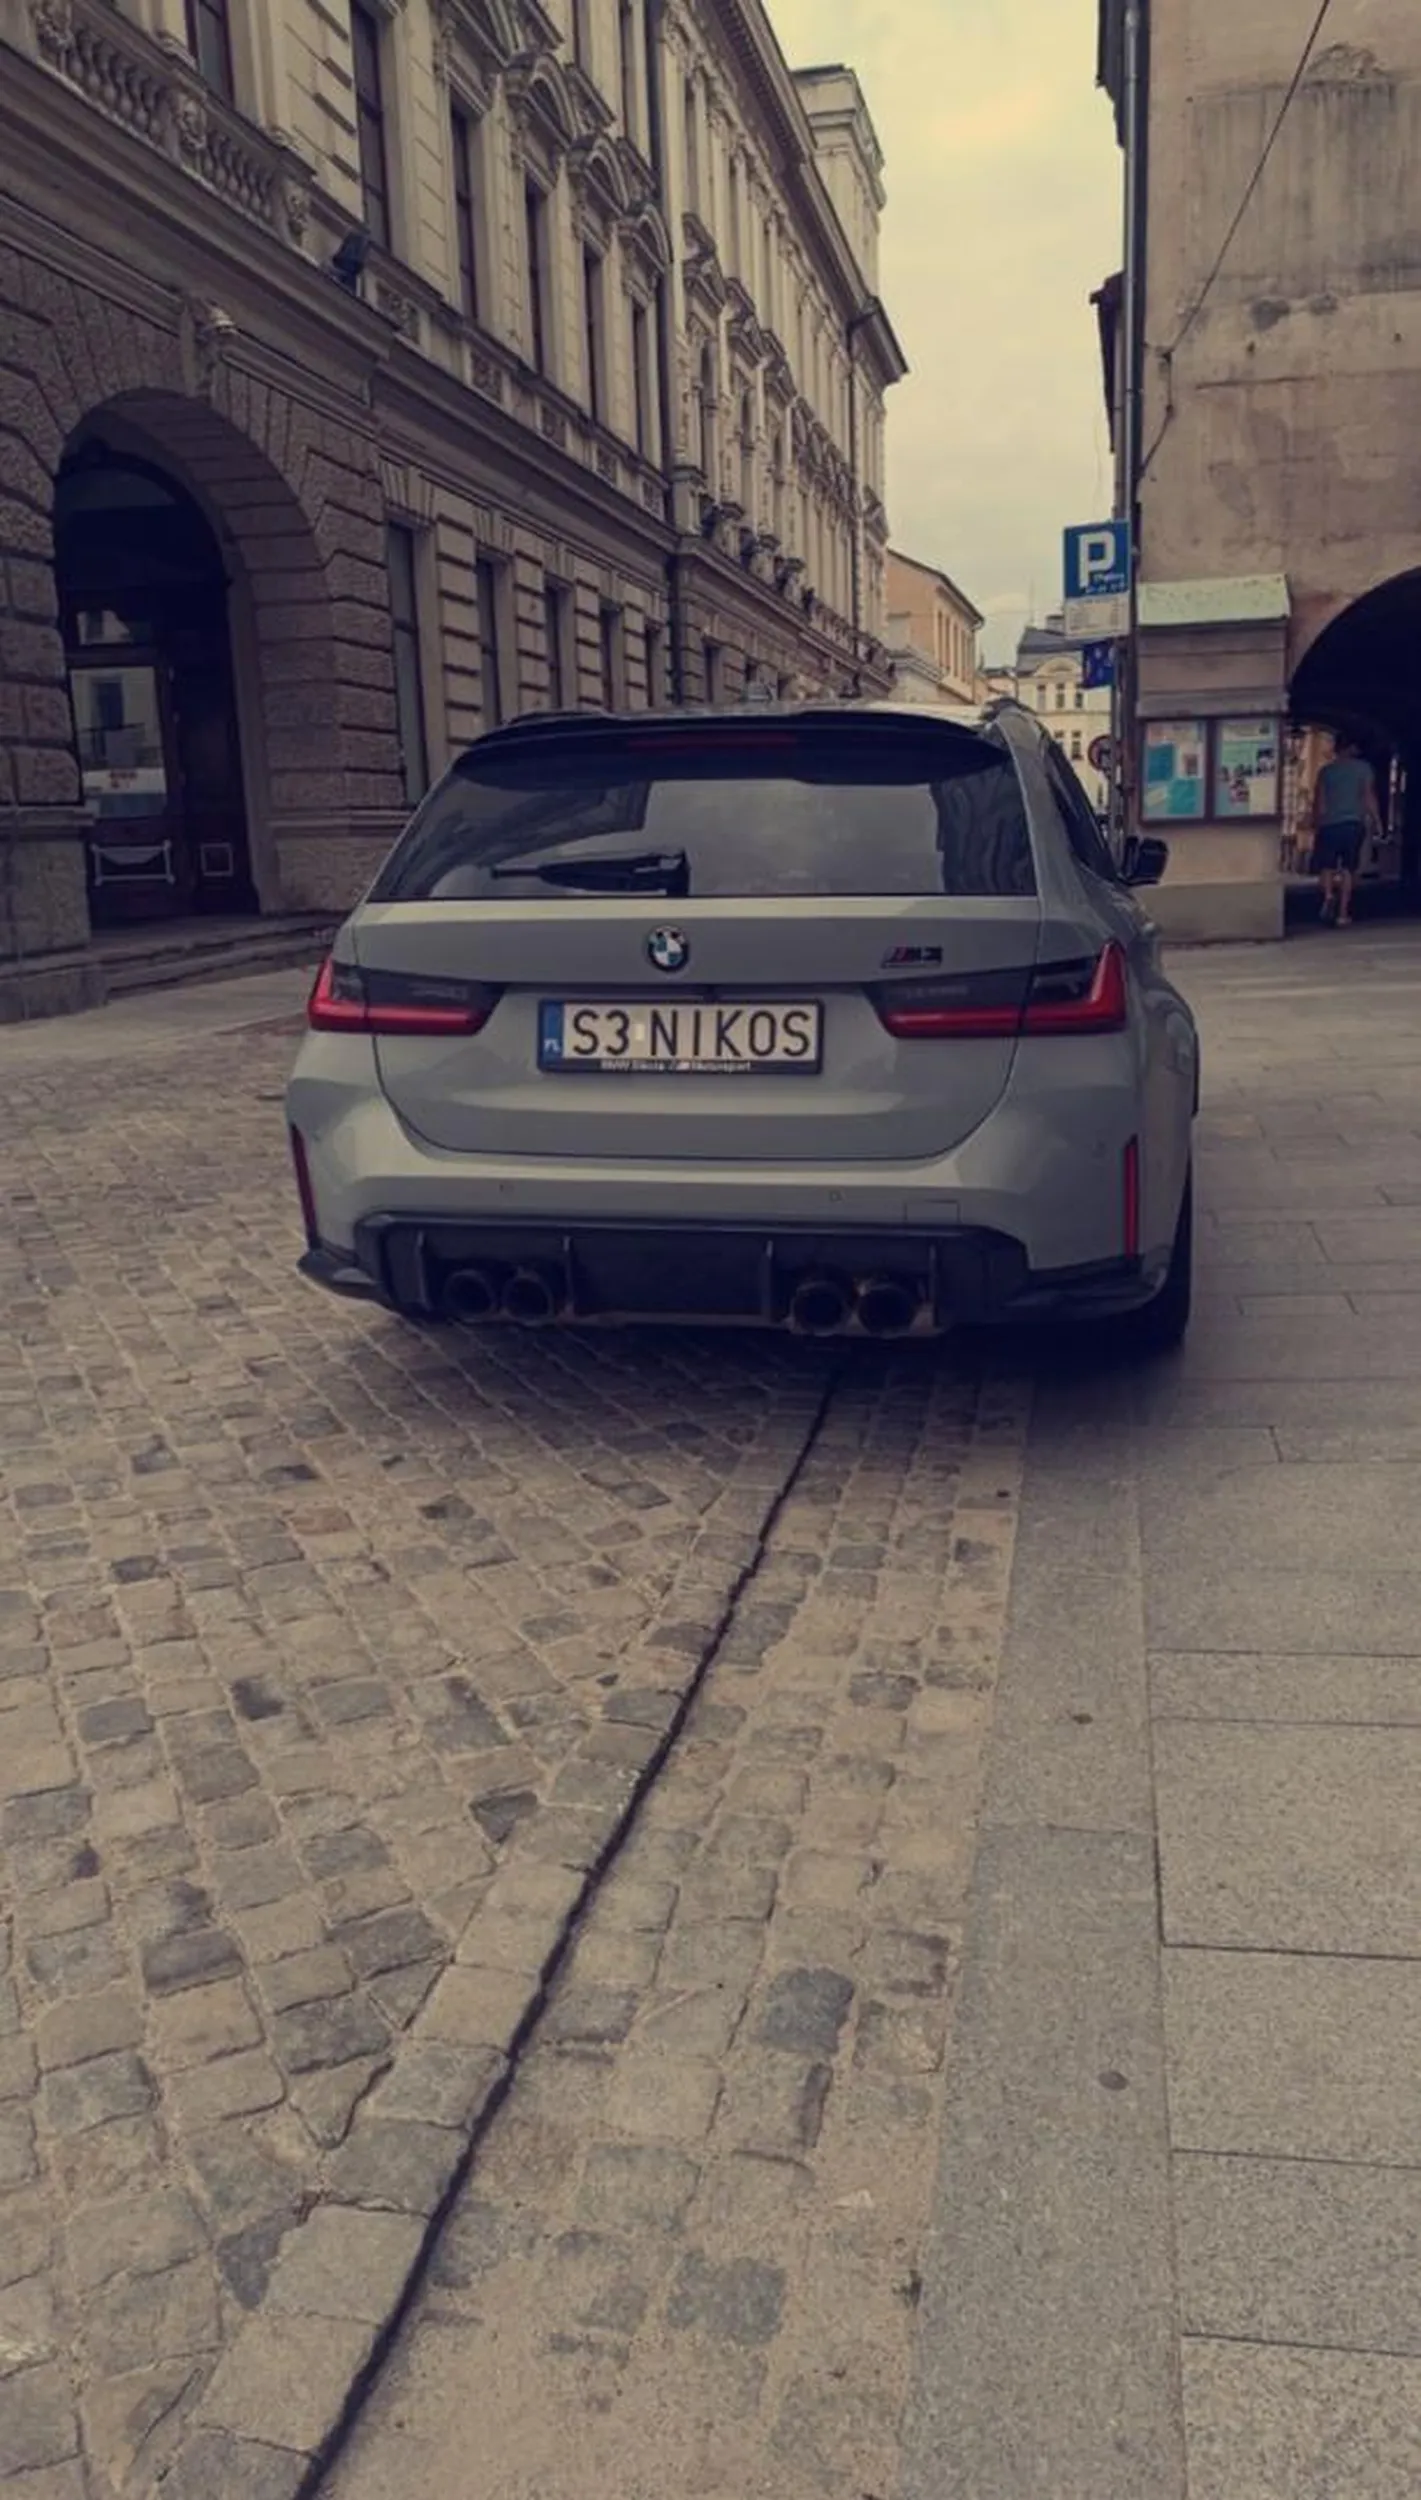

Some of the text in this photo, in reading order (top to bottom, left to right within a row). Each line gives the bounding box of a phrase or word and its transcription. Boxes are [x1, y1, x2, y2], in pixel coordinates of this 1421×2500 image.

[1078, 531, 1115, 588] P
[572, 1009, 811, 1056] S3 NIKOS
